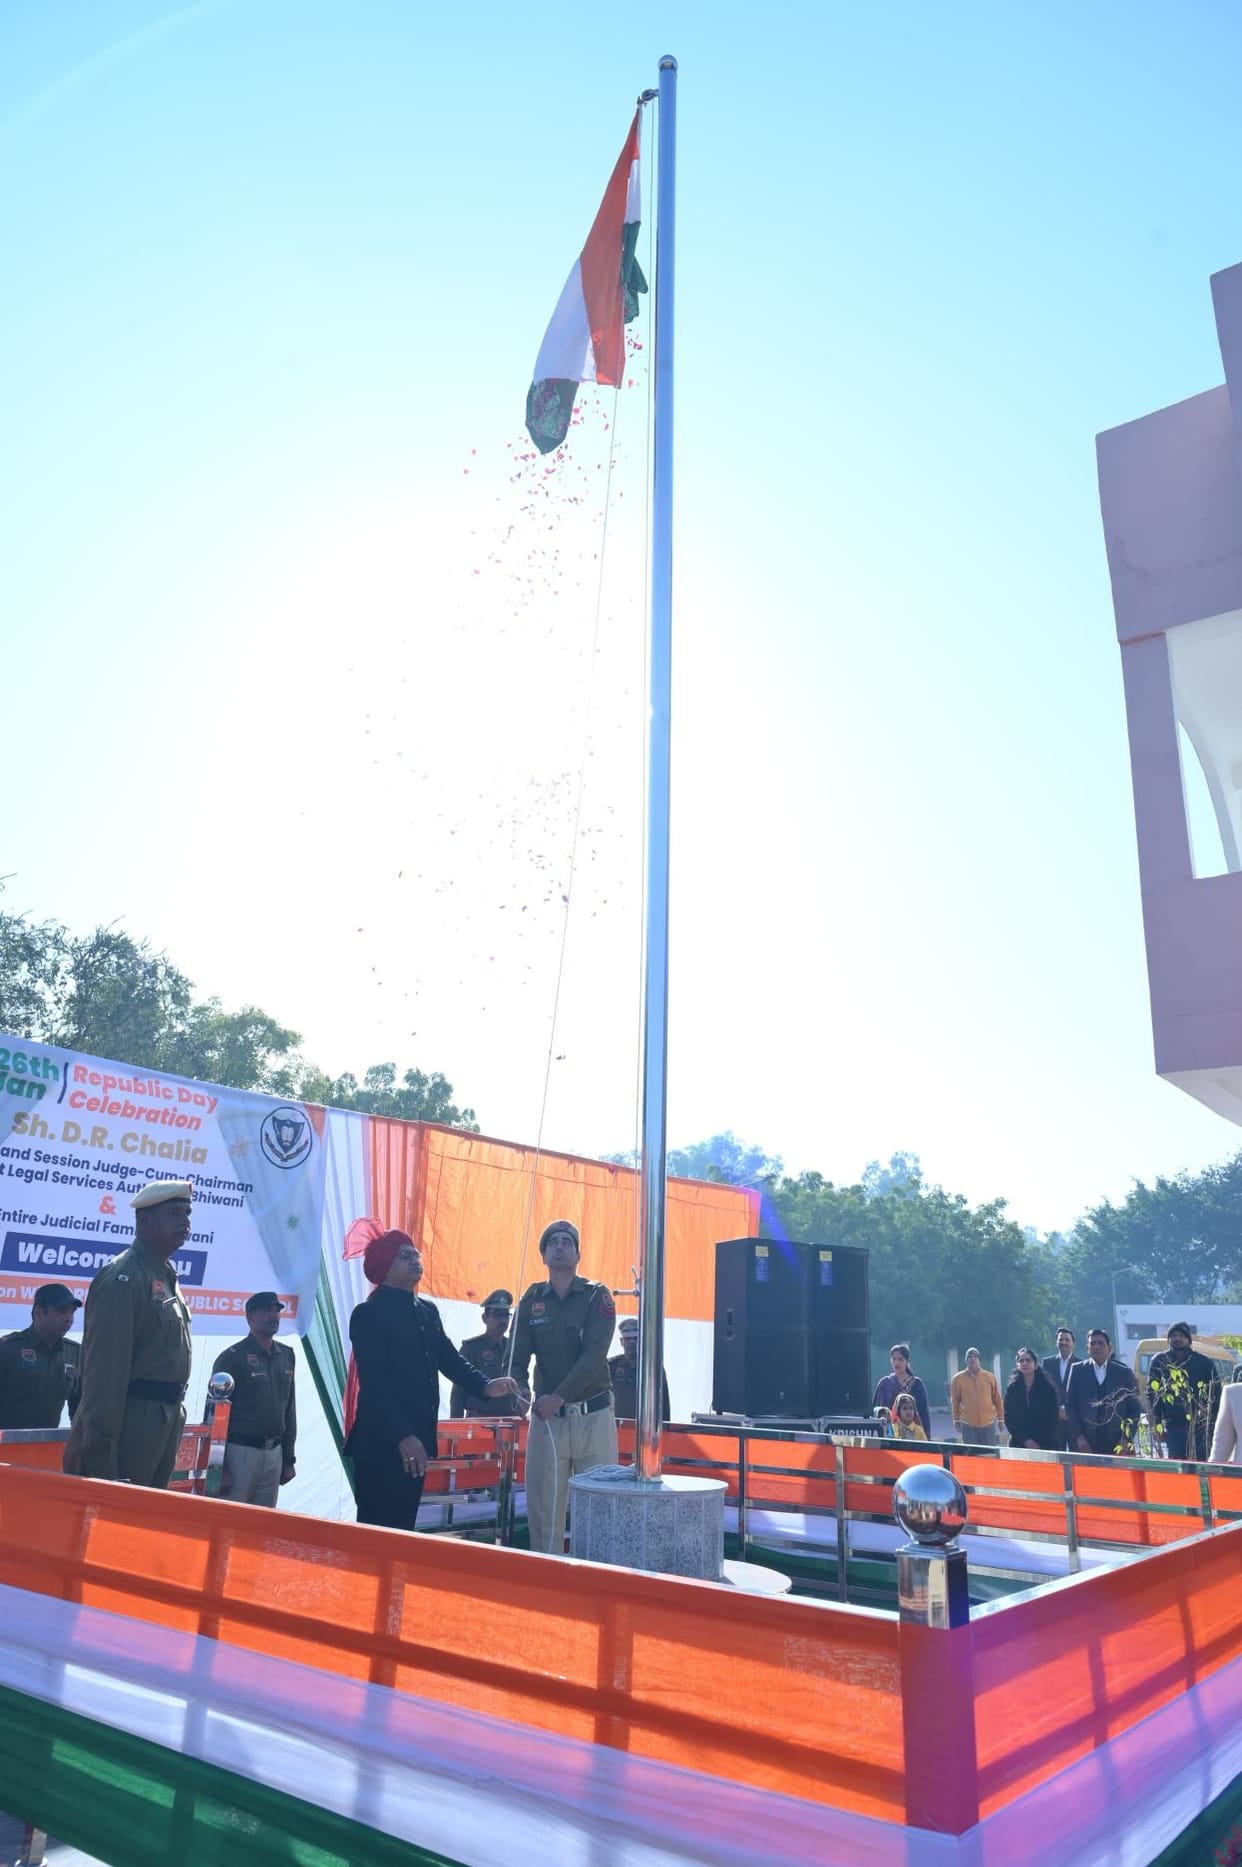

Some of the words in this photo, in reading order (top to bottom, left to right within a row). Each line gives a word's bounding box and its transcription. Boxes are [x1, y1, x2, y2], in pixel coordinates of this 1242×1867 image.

[73, 1064, 174, 1100] Republic
[178, 1087, 218, 1114] Day
[69, 1091, 202, 1130] Celebration
[12, 1111, 56, 1140] Sh.
[62, 1121, 114, 1150] D.R.
[120, 1132, 208, 1164] Chalia
[1, 1146, 32, 1160] and
[34, 1150, 90, 1170] Session
[8, 1164, 49, 1183] Legal
[52, 1171, 113, 1190] Services
[99, 1195, 116, 1215] &
[40, 1214, 101, 1232] Judicial
